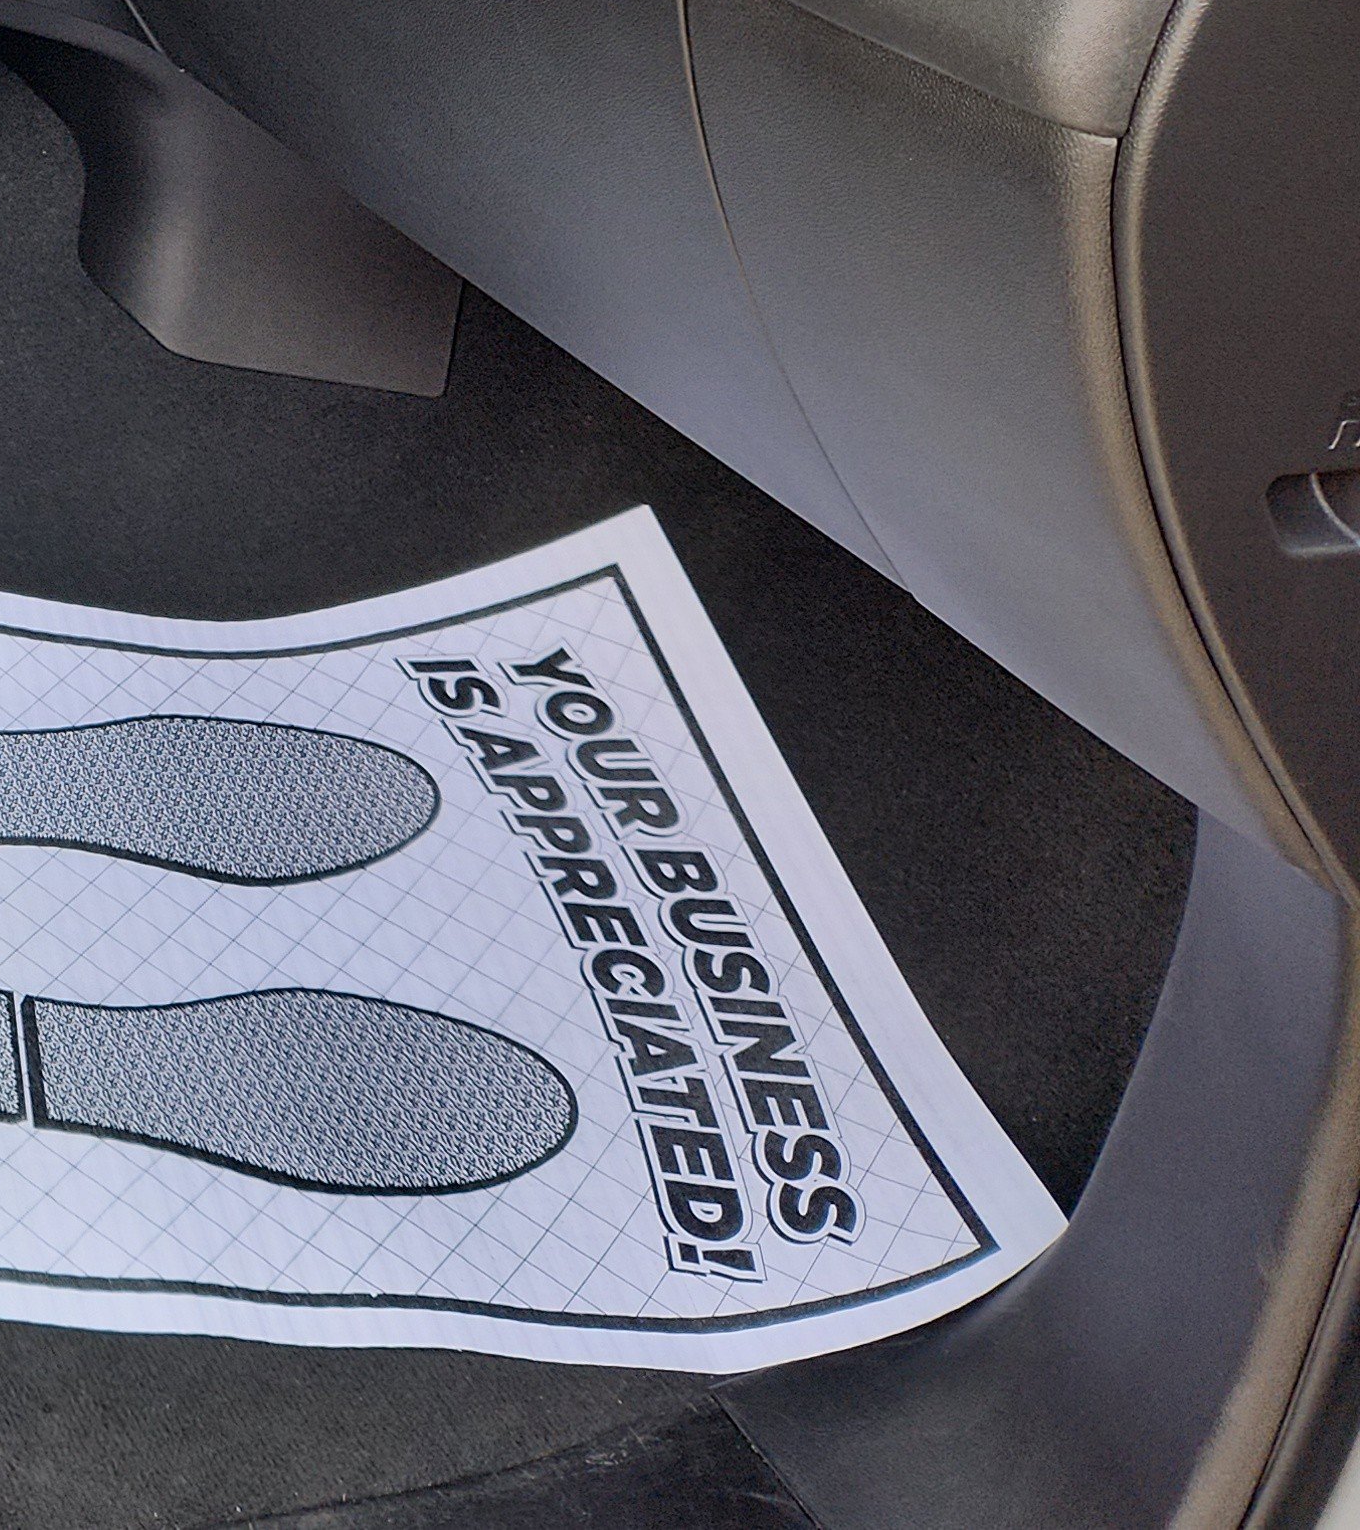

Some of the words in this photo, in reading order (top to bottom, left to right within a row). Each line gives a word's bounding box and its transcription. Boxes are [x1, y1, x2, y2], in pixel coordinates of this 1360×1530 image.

[396, 657, 506, 718] IS
[500, 642, 686, 838] YOUR
[622, 845, 862, 1243] BUSINESS
[443, 722, 763, 1281] APPRECIATED!
